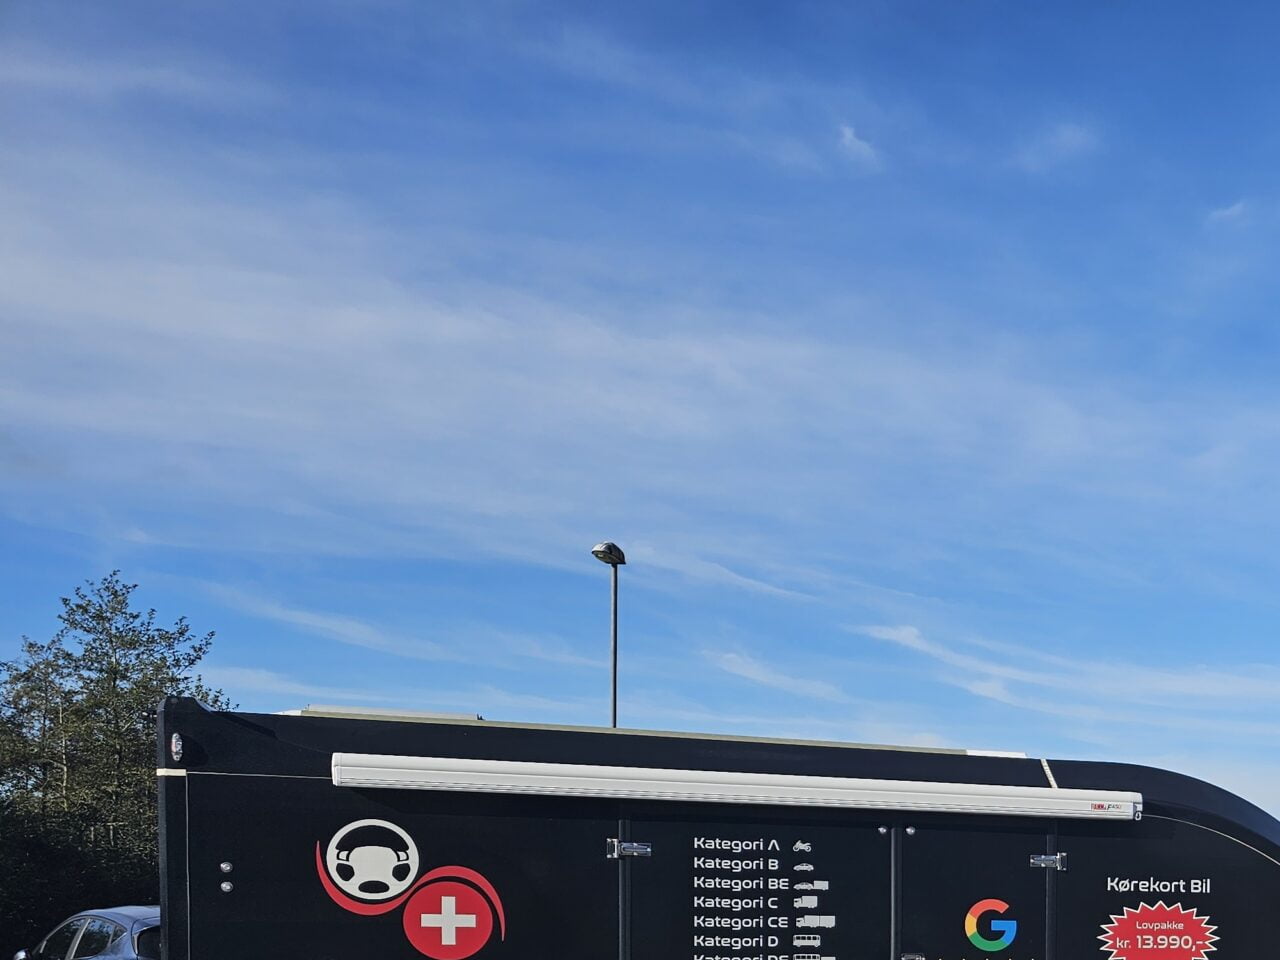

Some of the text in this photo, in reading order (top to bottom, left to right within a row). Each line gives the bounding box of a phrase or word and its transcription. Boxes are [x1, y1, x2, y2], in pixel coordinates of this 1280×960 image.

[694, 838, 779, 852] Kategori A
[694, 857, 778, 872] Kategori B
[694, 877, 788, 891] Kategori BE
[1108, 877, 1210, 893] Kørekort Bil
[694, 897, 777, 911] Kategori C
[694, 916, 788, 930] Kategori CE
[1136, 921, 1183, 931] Lovpakke
[694, 935, 778, 949] Kategori D
[1116, 935, 1203, 951] kr. 13.990,-
